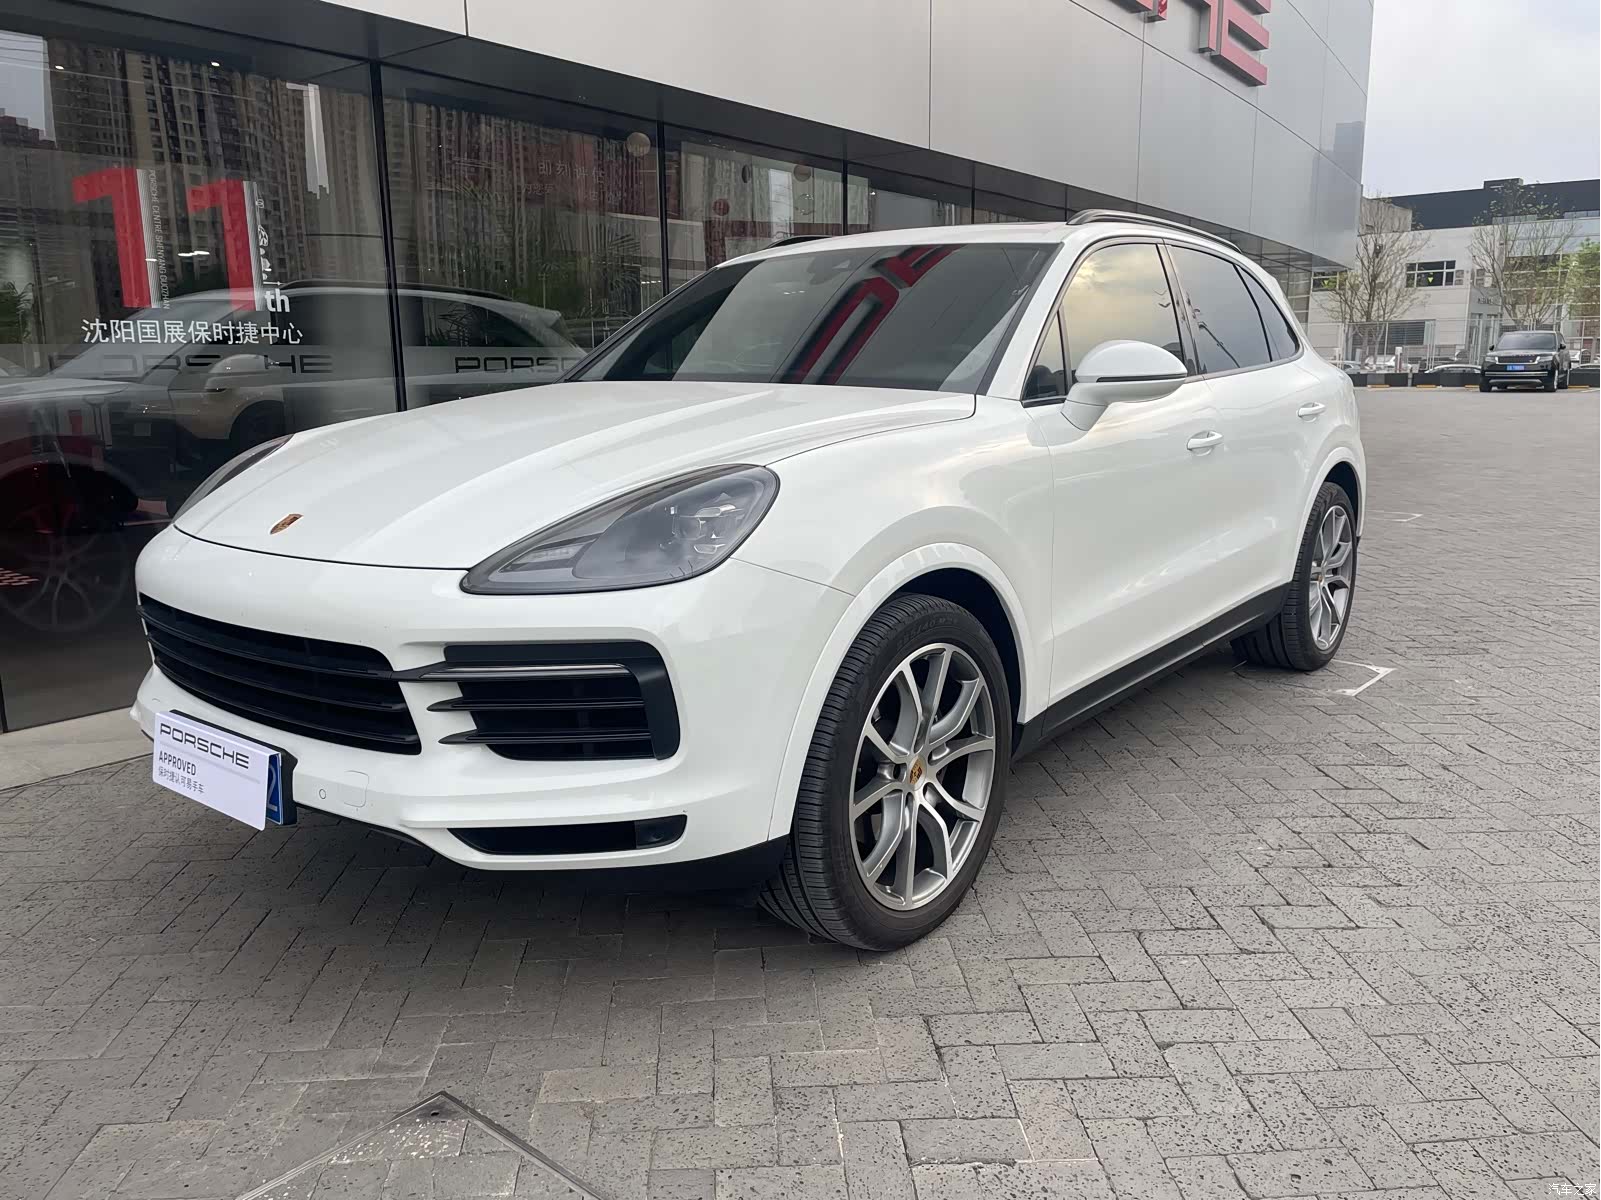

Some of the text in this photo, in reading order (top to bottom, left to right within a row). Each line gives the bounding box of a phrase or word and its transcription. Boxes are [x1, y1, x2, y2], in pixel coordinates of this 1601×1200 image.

[152, 205, 162, 233] CENTRE
[155, 235, 166, 273] SHENYANG
[160, 275, 170, 309] GUOZHAN
[81, 318, 303, 345] 沈阳国展保时捷中心
[159, 723, 249, 769] PORSCHE
[158, 751, 197, 776] APPROVED
